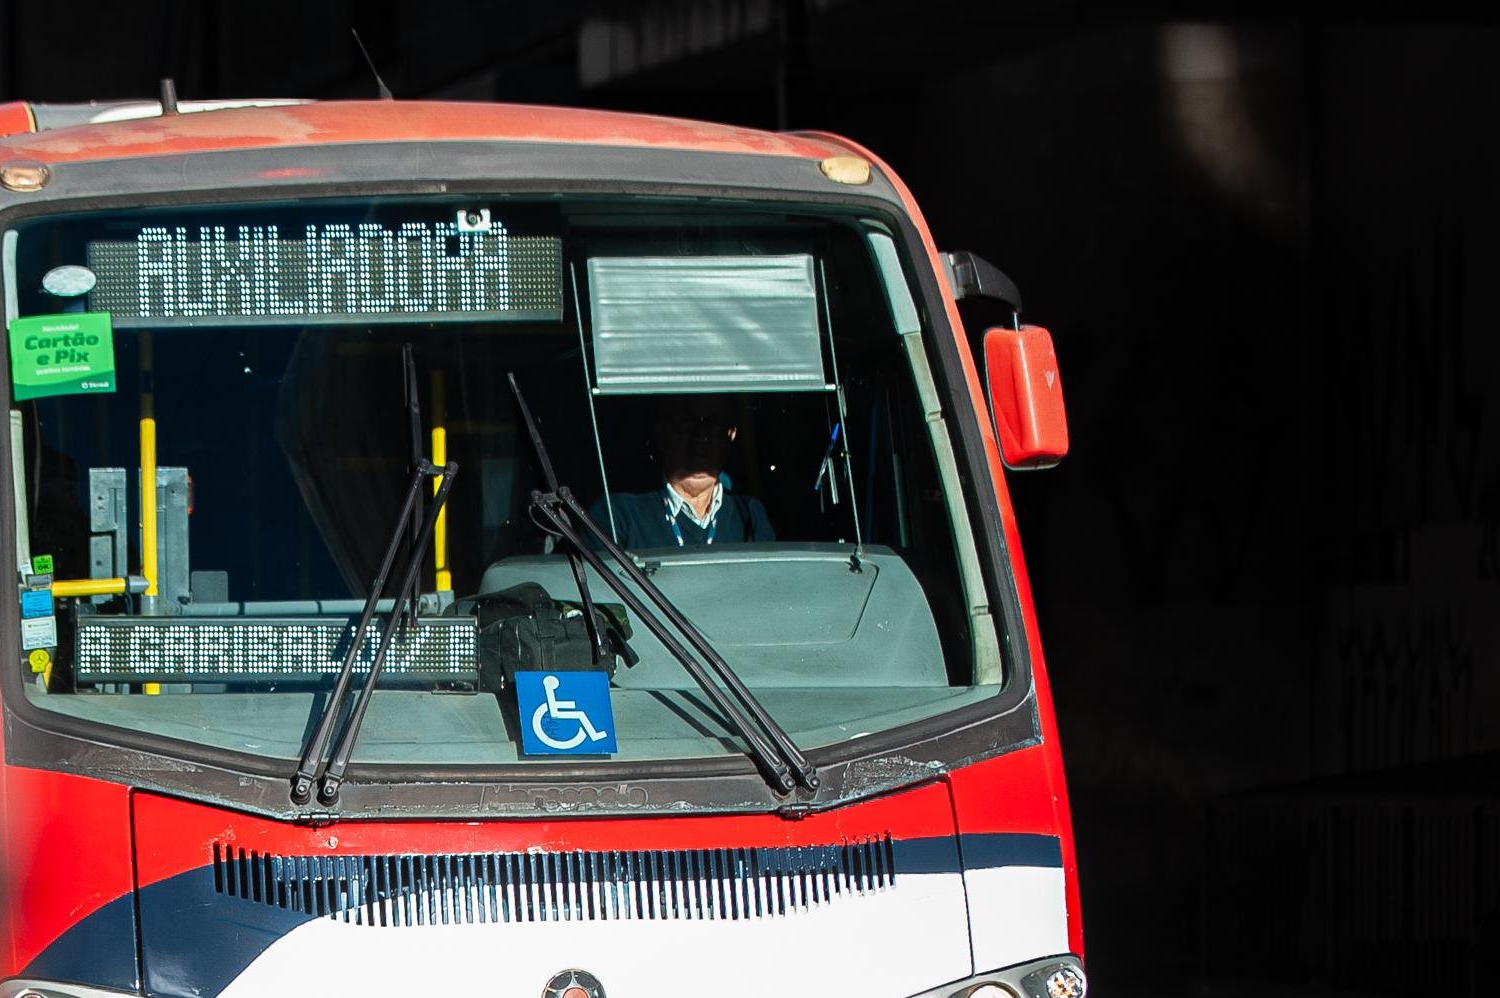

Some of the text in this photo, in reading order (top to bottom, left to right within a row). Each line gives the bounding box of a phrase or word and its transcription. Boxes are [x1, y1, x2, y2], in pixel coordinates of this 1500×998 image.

[137, 222, 508, 317] AUXILIADORA
[24, 332, 100, 351] Cartão
[36, 348, 90, 365] e Pix
[80, 626, 110, 674] A
